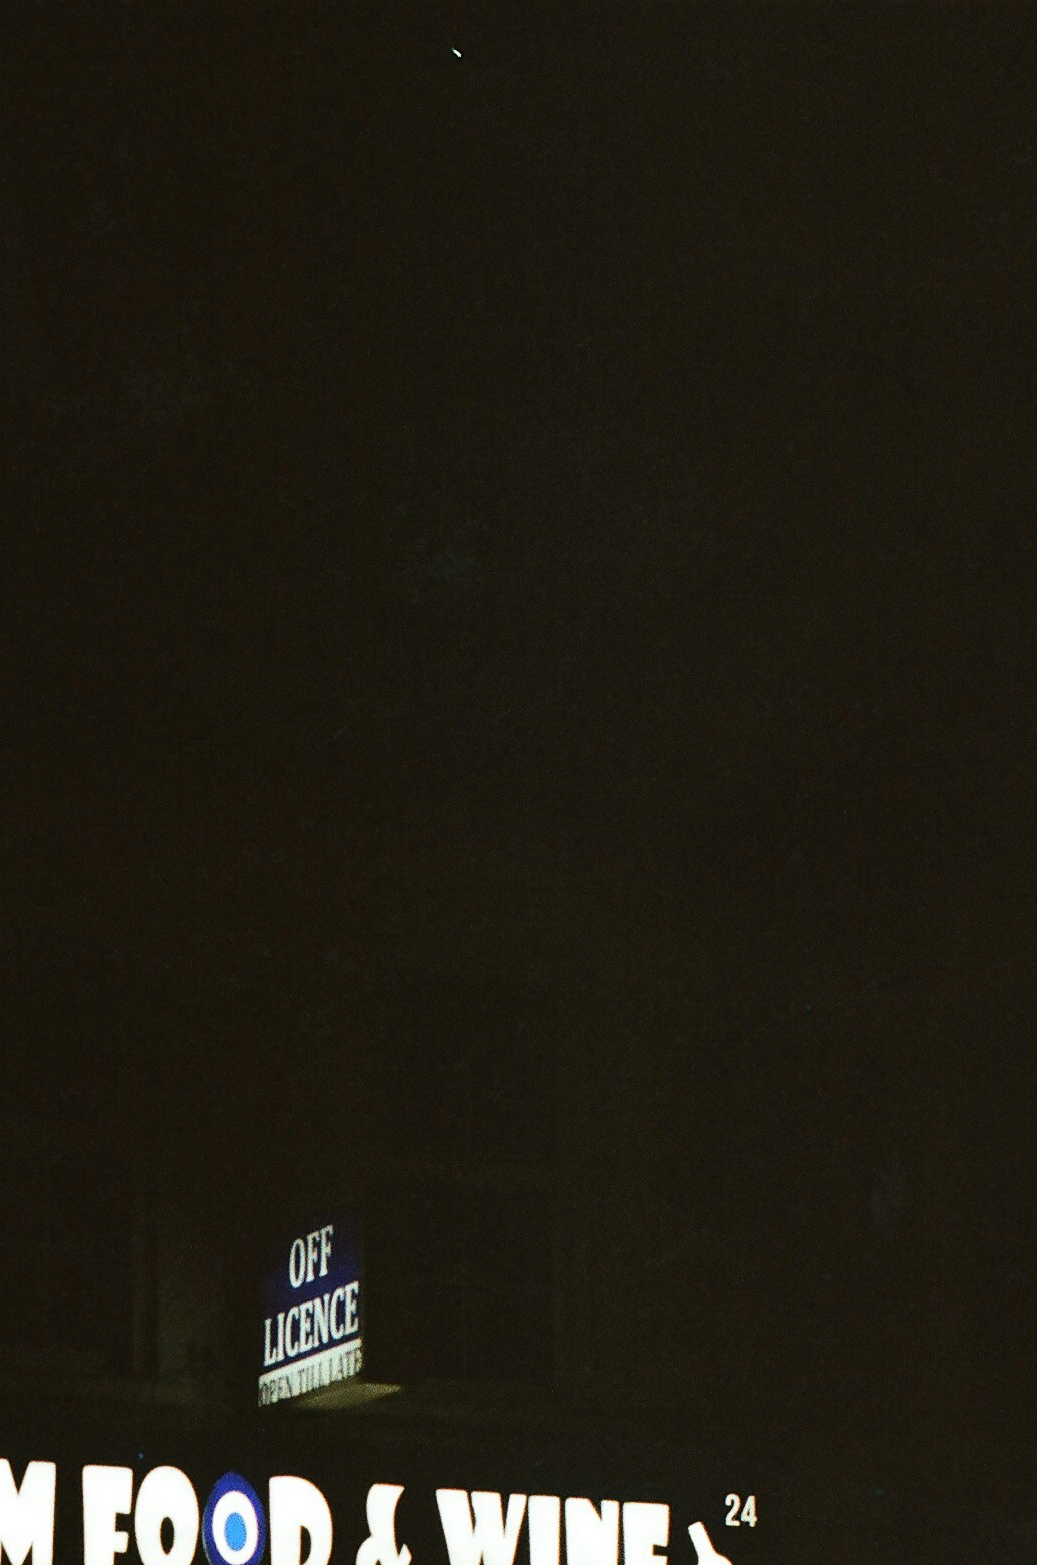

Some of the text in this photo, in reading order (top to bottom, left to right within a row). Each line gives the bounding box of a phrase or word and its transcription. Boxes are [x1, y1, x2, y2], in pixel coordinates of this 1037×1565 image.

[289, 1225, 334, 1289] OFF
[263, 1281, 360, 1367] LICENCE
[724, 1493, 758, 1528] 24
